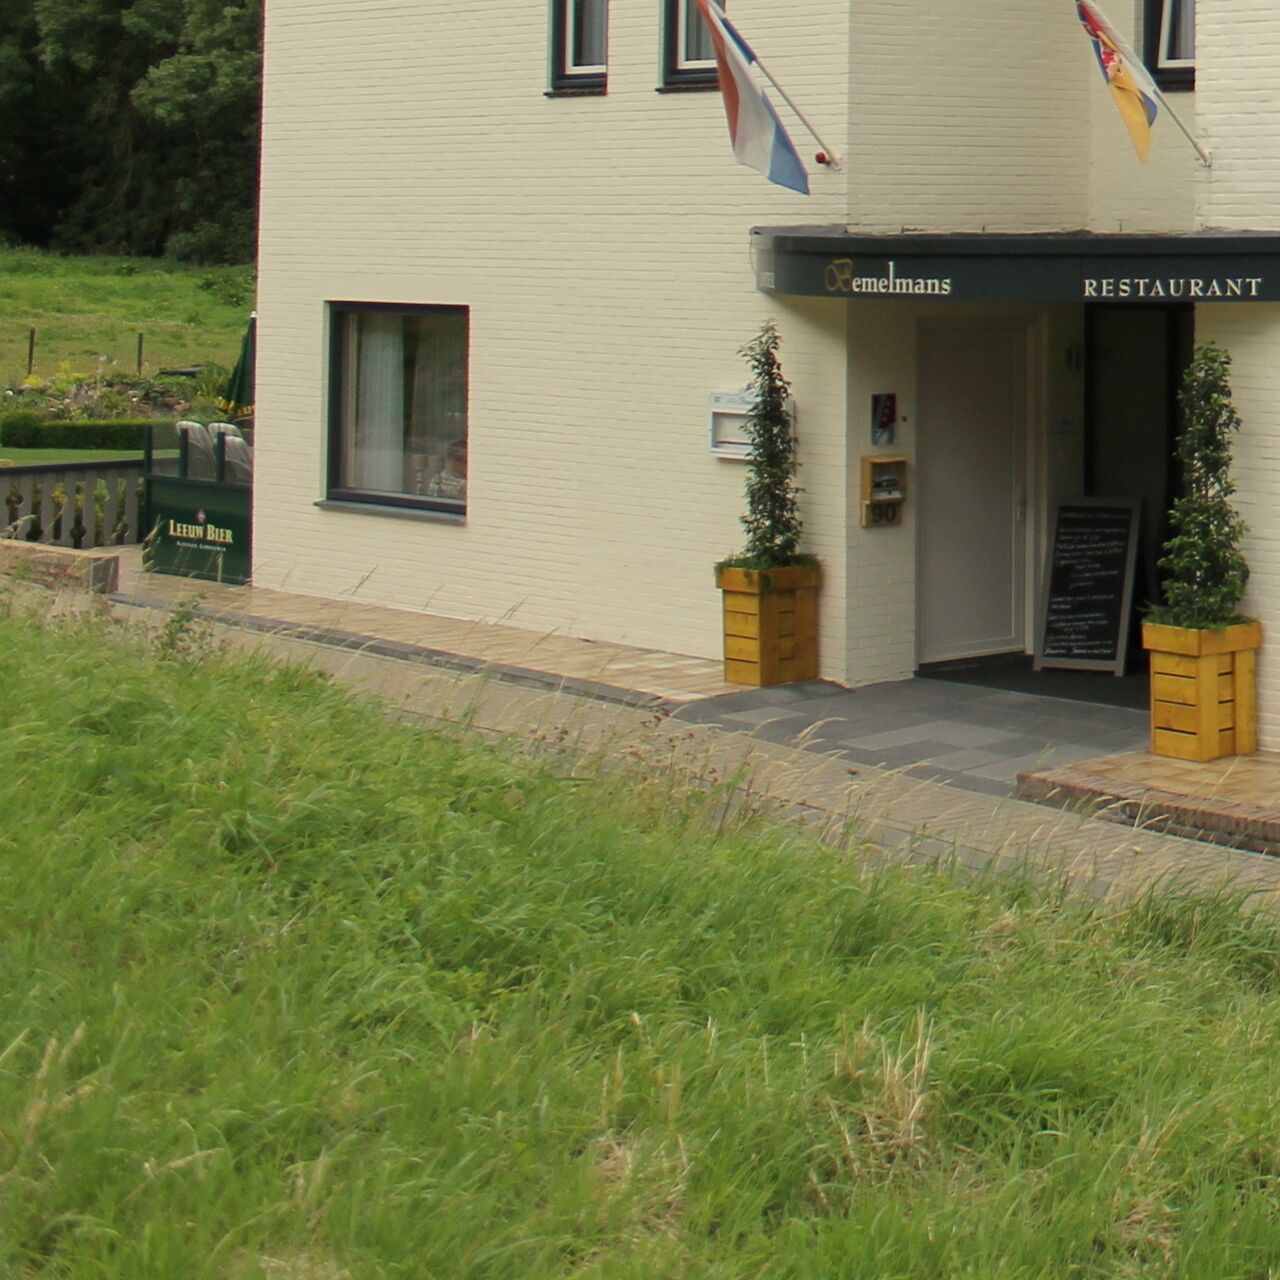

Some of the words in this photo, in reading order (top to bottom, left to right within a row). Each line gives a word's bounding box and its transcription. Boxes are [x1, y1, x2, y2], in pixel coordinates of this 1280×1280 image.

[825, 259, 951, 294] Bemelmans
[1083, 278, 1262, 297] RESTAURANT
[206, 524, 233, 543] BIER
